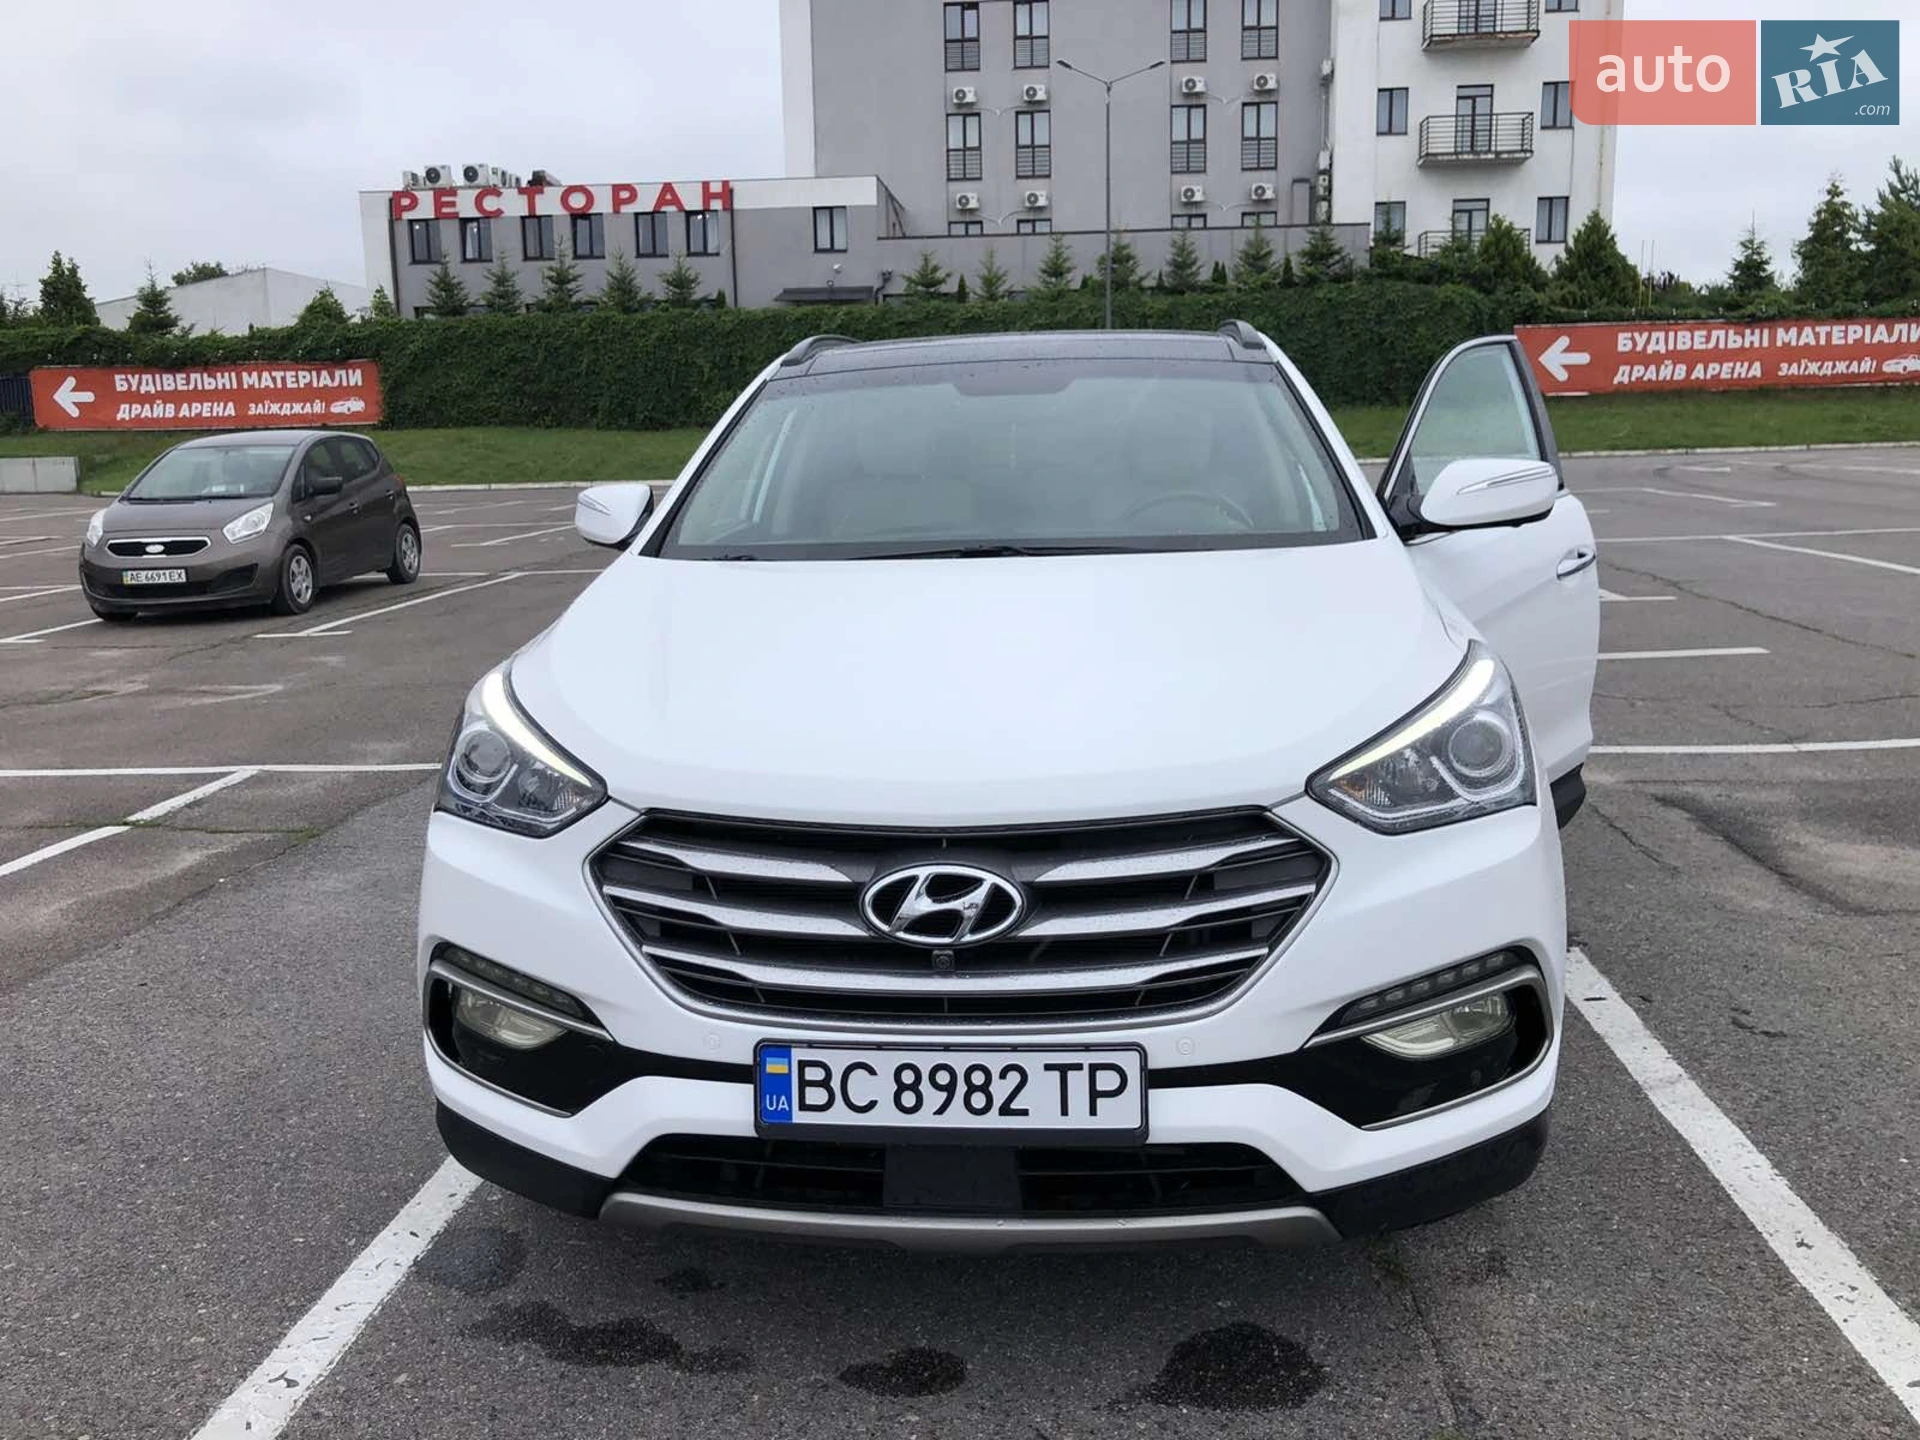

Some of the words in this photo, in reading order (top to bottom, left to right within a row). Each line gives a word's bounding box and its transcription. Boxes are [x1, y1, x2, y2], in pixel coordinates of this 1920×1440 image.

[390, 180, 731, 221] РЕСТОРАН
[1617, 327, 1770, 354] БУДІВЕЛЬНІ
[1613, 360, 1687, 384] ДРАЙВ
[1690, 360, 1762, 380] АРЕНА
[1777, 356, 1877, 377] ЗАЇЖДЖАЙ!
[114, 371, 237, 394] БУДІВЕЛЬНІ
[241, 368, 363, 389] МАТЕРІАЛИ
[116, 399, 175, 421] ДРАЙВ
[178, 401, 236, 418] АРЕНА
[248, 399, 325, 416] ЗАЇЖДЖАЙ!
[130, 571, 143, 583] AE
[168, 570, 184, 581] EX
[797, 1059, 879, 1114] BC
[893, 1061, 1030, 1117] 8982
[1043, 1062, 1129, 1117] TP
[766, 1094, 790, 1112] UA
